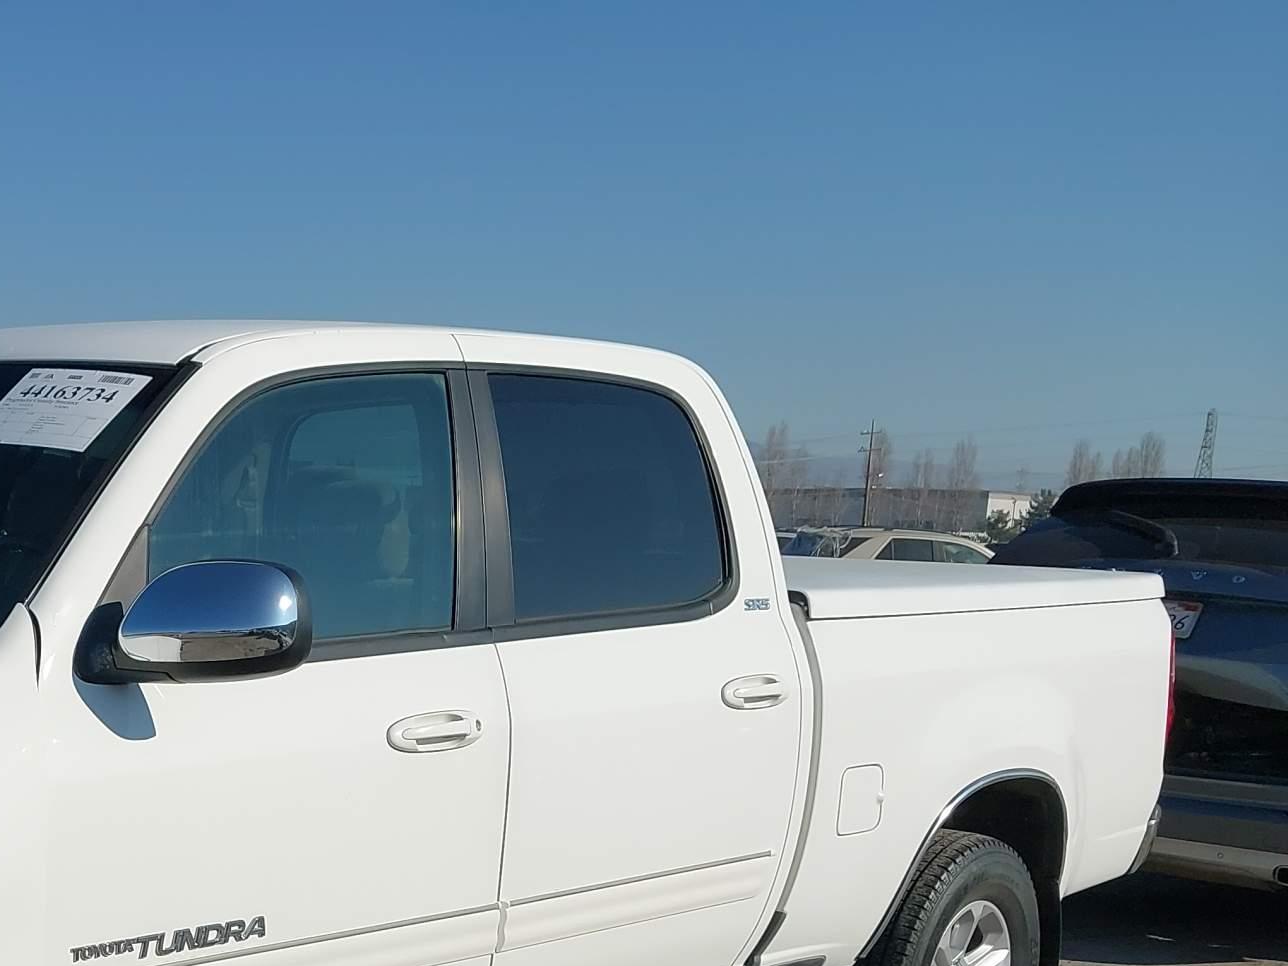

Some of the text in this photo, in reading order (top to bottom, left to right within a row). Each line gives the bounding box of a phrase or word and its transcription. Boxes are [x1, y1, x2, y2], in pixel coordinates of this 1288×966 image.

[20, 384, 119, 403] 44163734
[69, 915, 265, 963] TOYOTA TUNDRA
